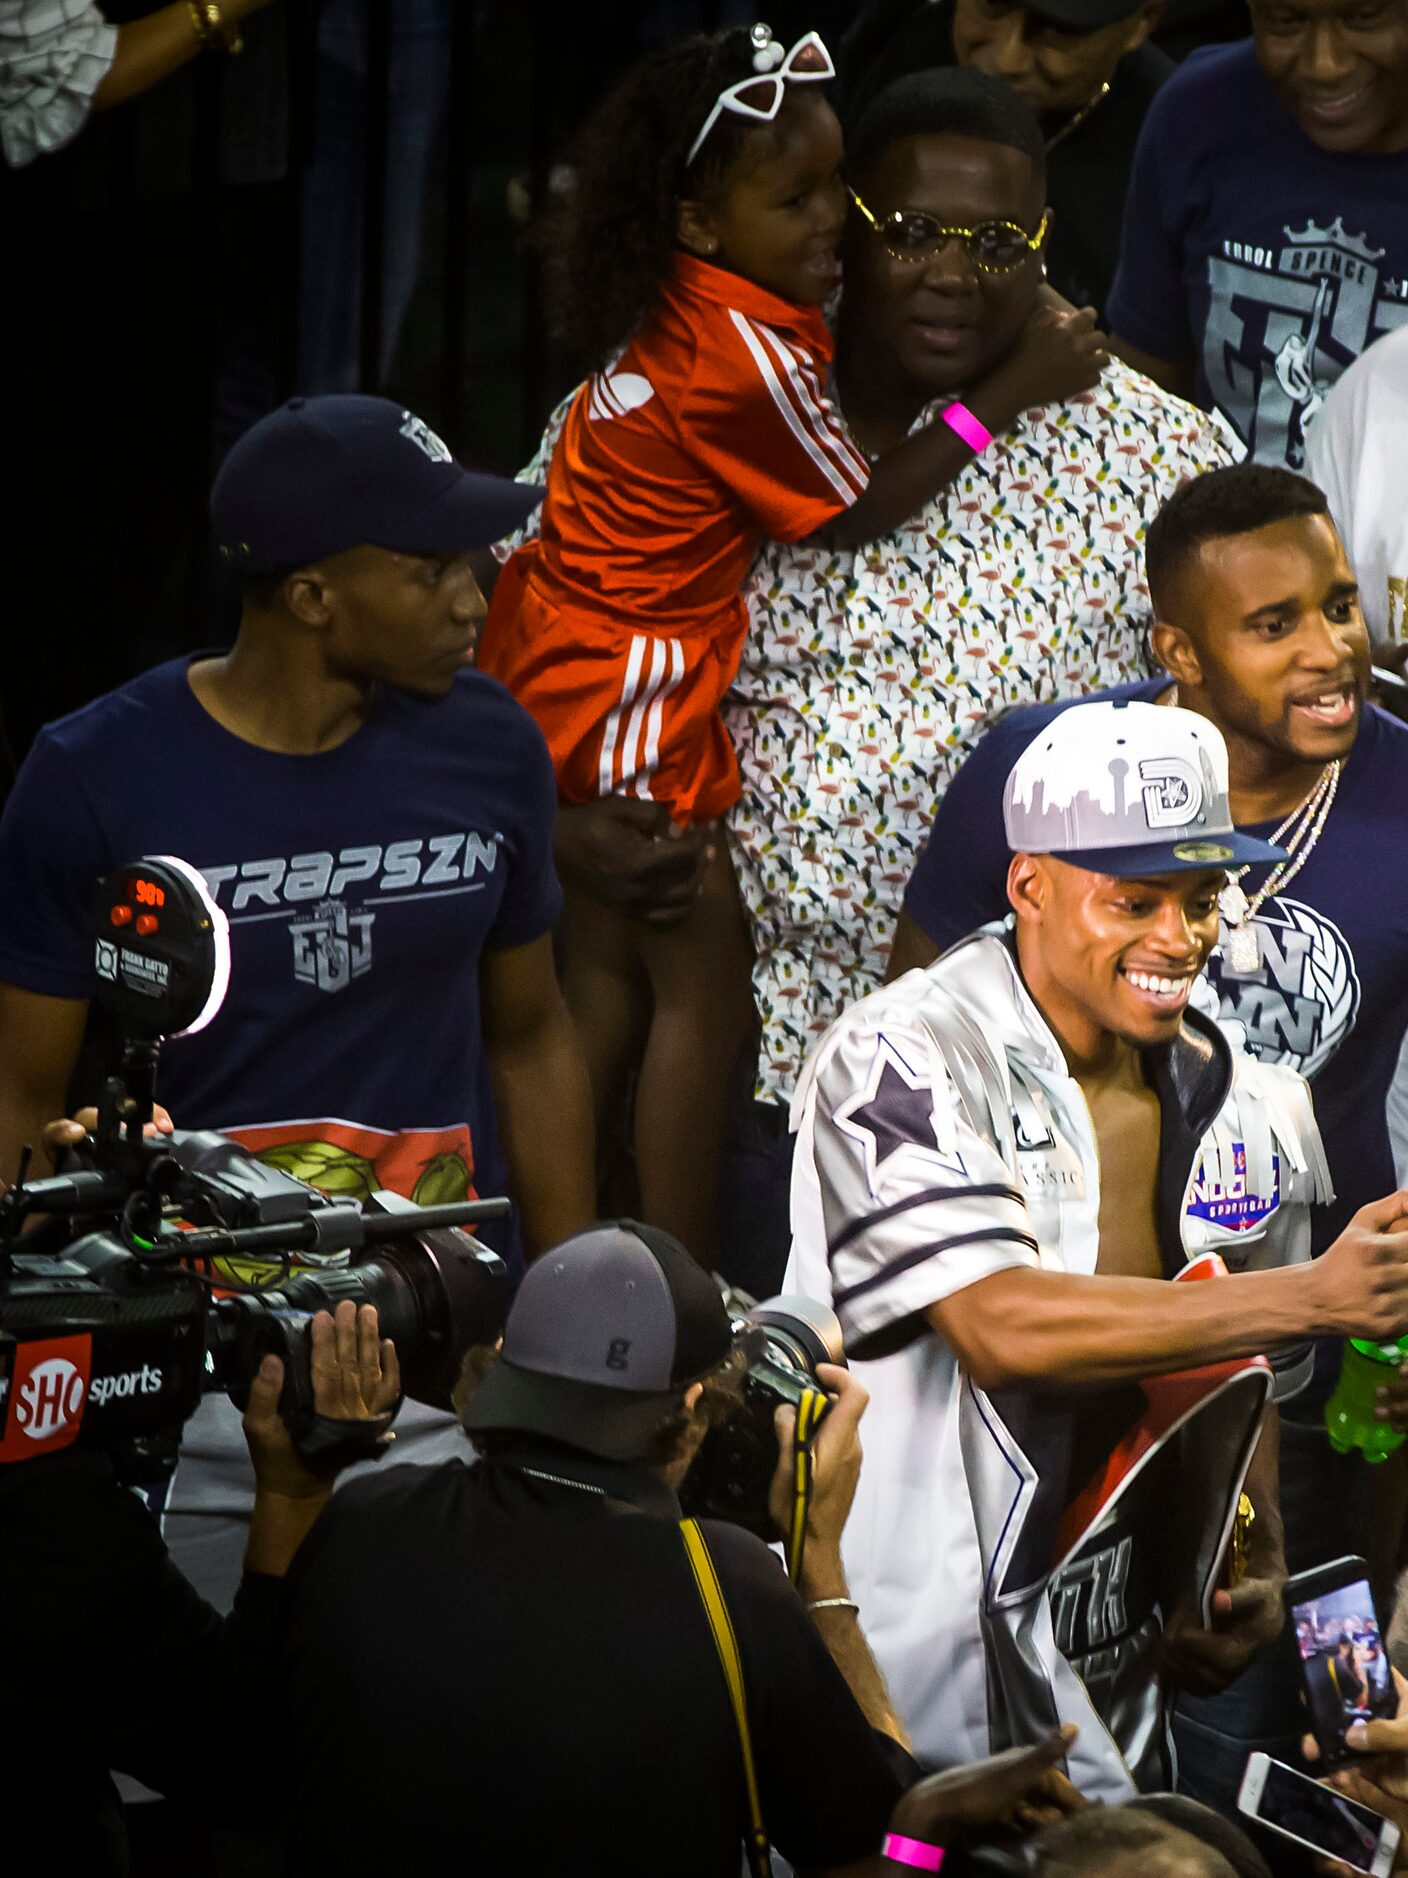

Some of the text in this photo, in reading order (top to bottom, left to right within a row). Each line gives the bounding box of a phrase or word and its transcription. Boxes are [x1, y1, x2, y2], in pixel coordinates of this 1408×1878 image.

[1291, 252, 1367, 285] SPENCE
[605, 1340, 631, 1371] g
[16, 1362, 86, 1438] SHO
[88, 1364, 163, 1407] sports
